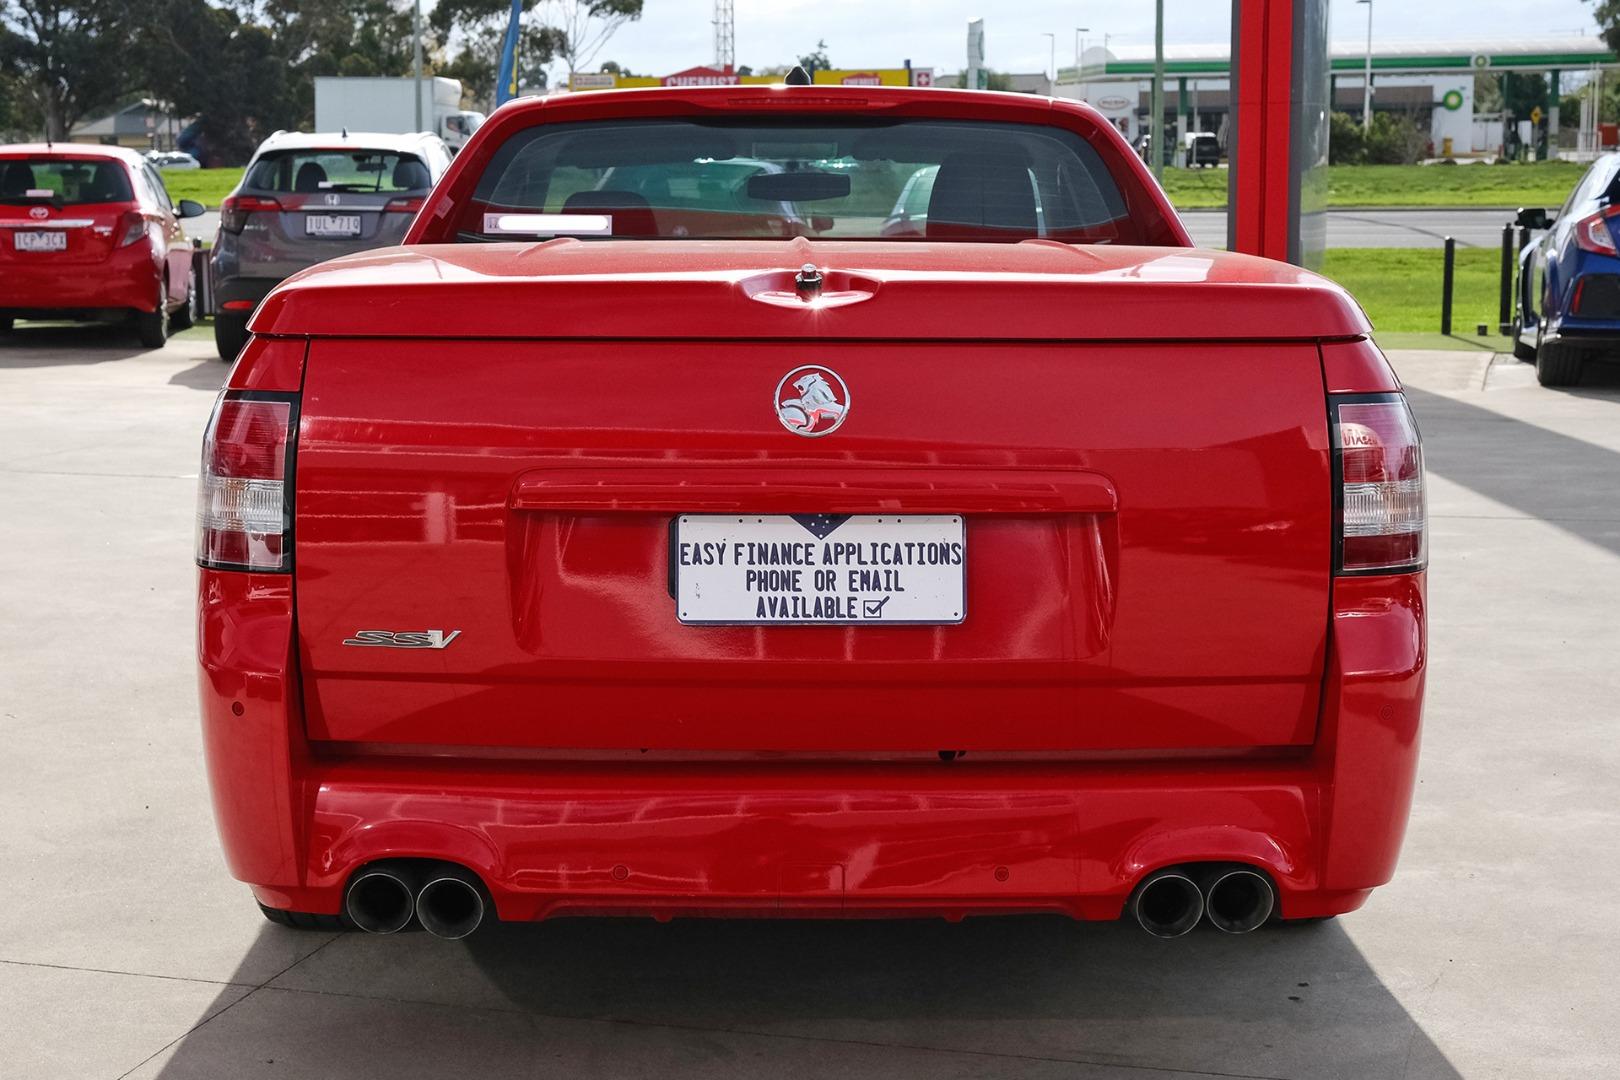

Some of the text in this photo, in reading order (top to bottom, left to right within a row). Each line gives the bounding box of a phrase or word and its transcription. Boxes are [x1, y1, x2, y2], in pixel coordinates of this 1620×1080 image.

[680, 543, 962, 565] EASY FINANCE APPLICATIONS
[746, 570, 905, 592] PHONE OR EMAIL
[756, 596, 858, 618] AVAILABLE
[342, 629, 462, 649] SSV
